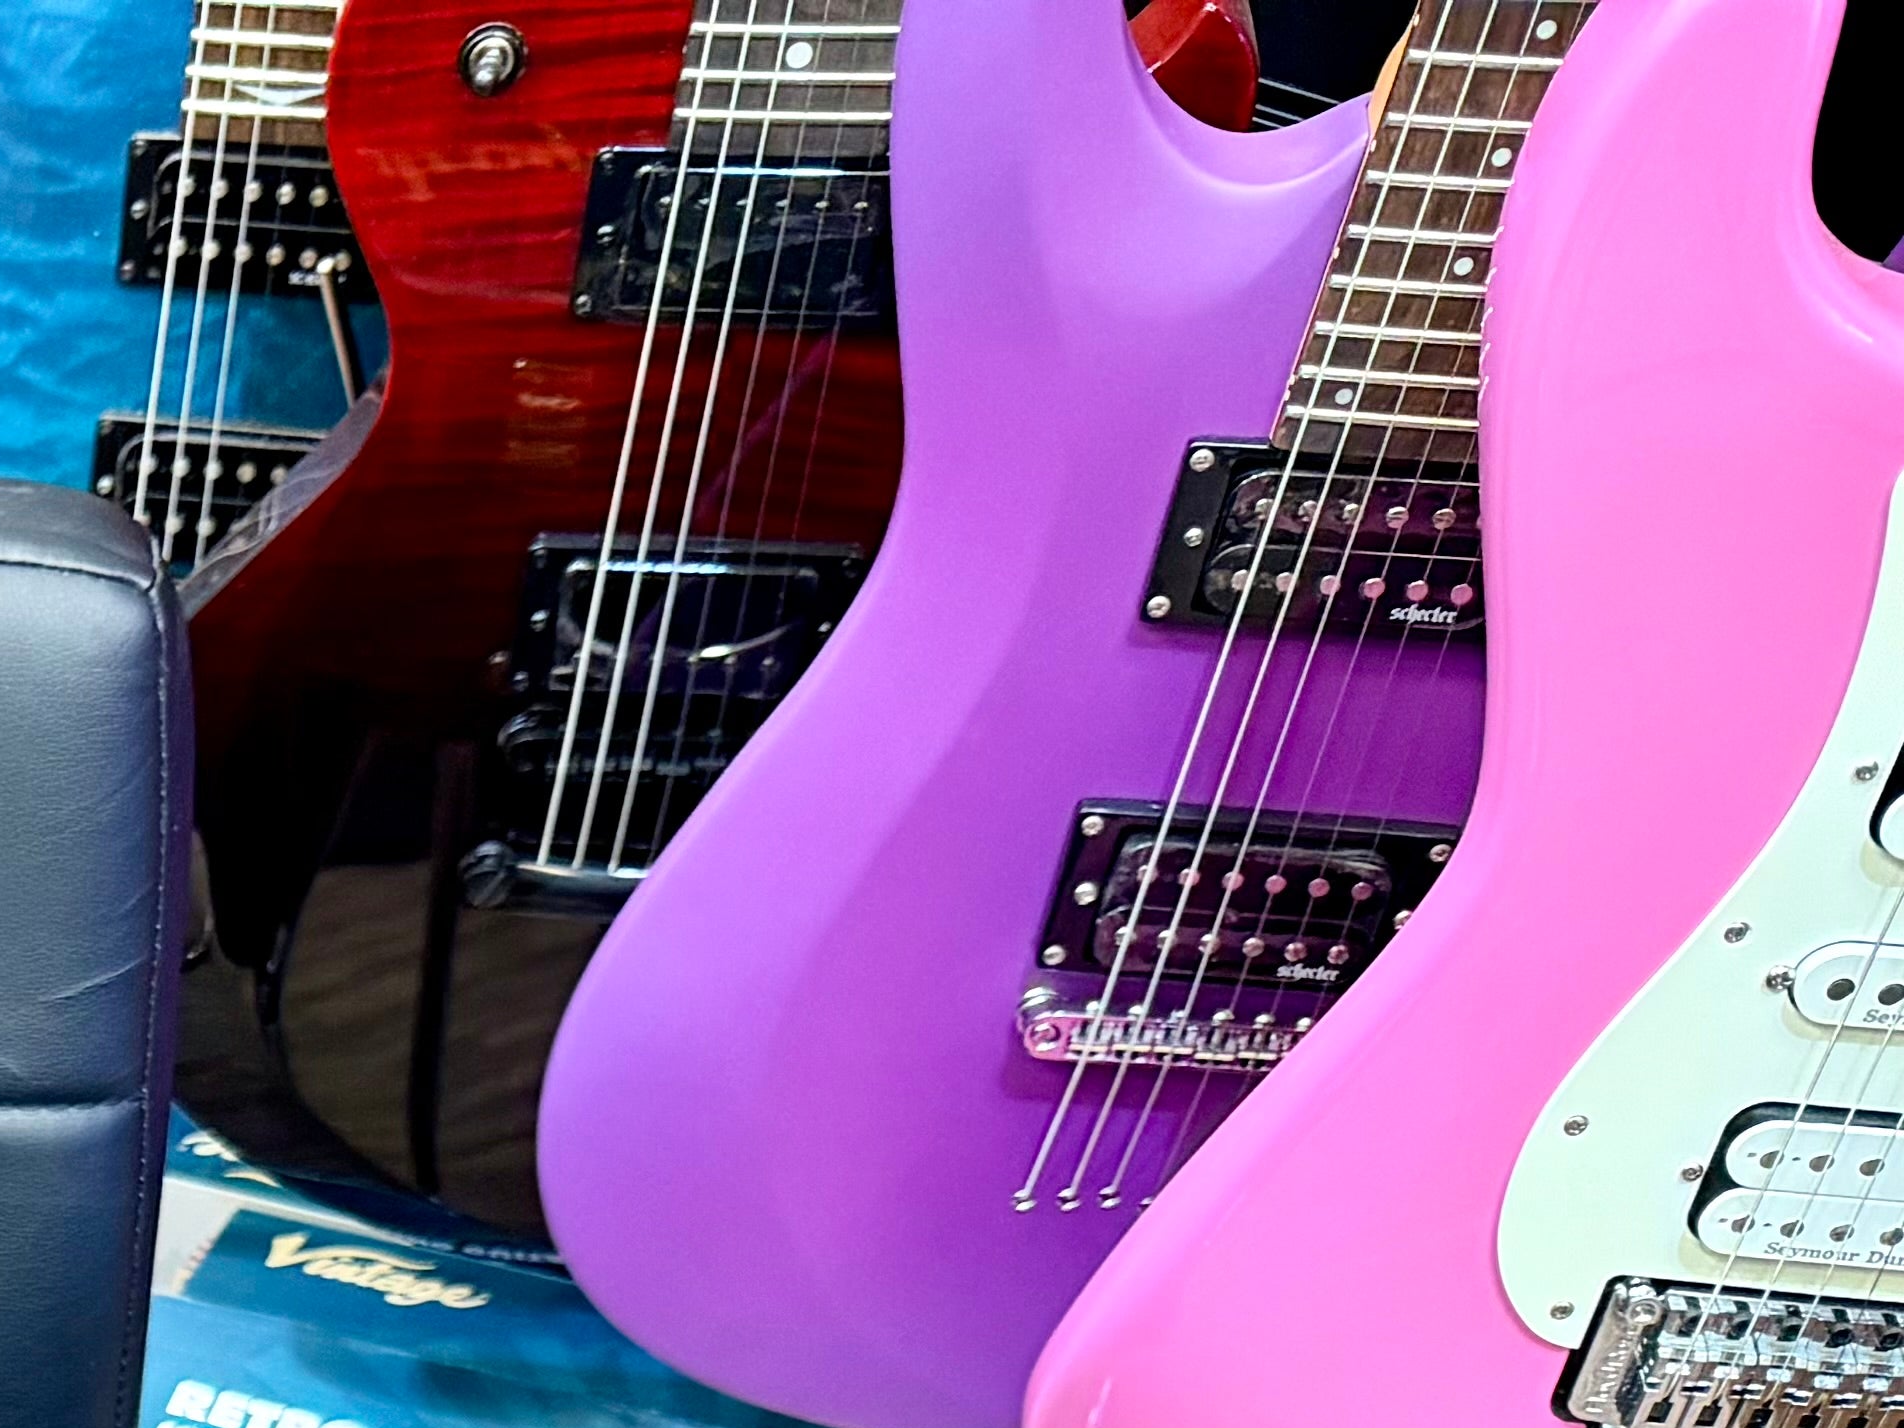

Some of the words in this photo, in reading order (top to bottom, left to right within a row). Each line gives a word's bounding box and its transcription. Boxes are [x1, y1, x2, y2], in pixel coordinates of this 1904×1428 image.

[1389, 603, 1459, 625] schecter
[1275, 962, 1341, 983] schecter
[1763, 1241, 1861, 1263] Seymour
[264, 1230, 491, 1310] Vintage
